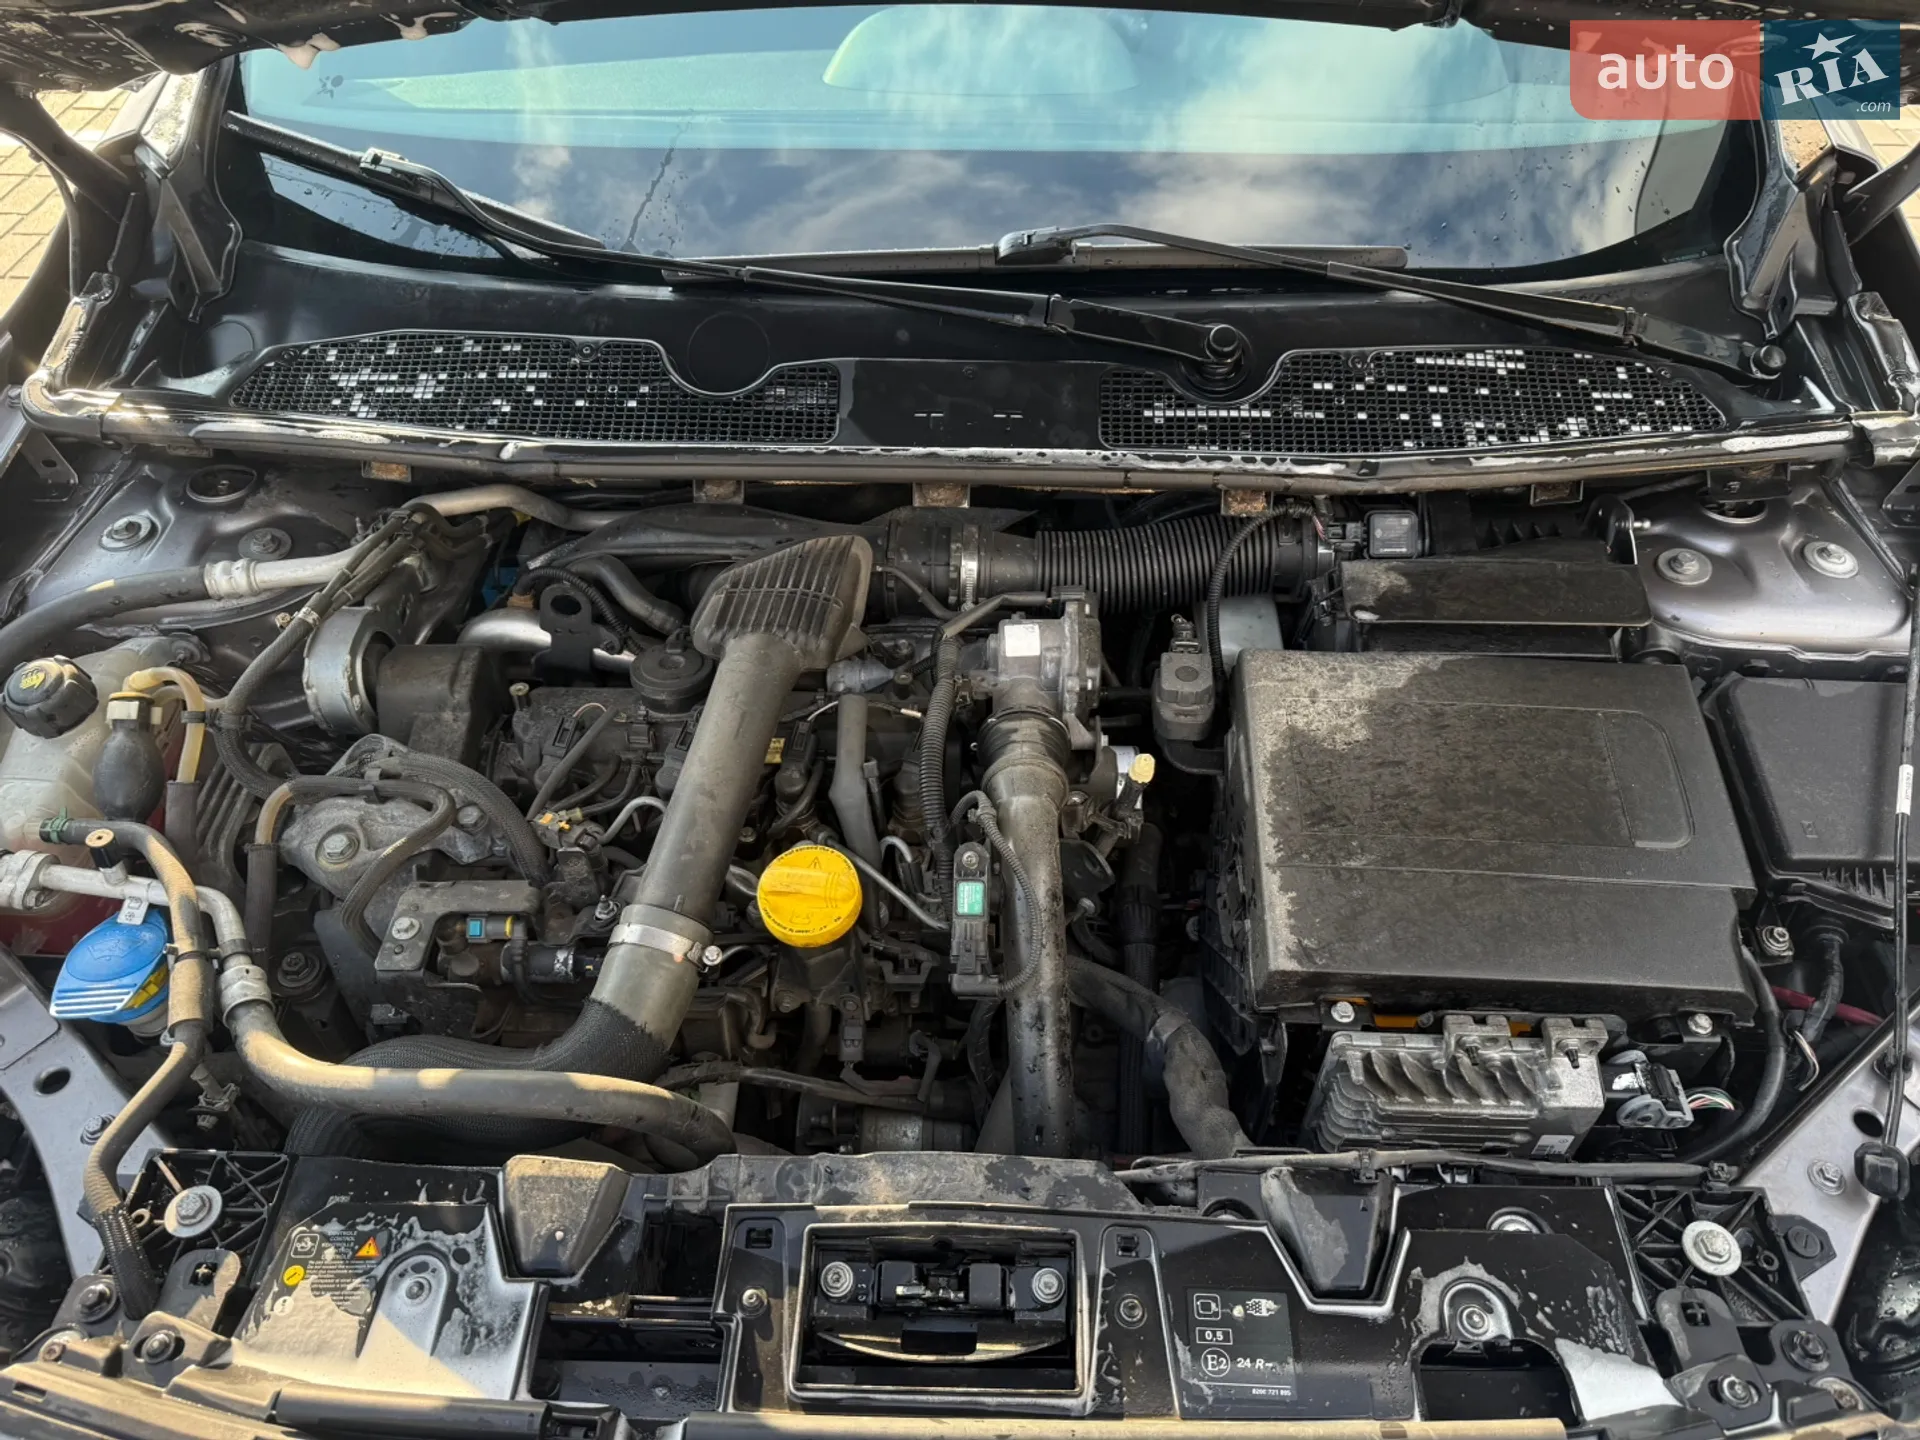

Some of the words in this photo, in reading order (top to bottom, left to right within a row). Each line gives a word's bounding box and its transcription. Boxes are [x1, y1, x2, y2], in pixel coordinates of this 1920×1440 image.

[1205, 1331, 1224, 1341] 0,5
[1206, 1354, 1228, 1371] E2
[1236, 1357, 1251, 1368] 24
